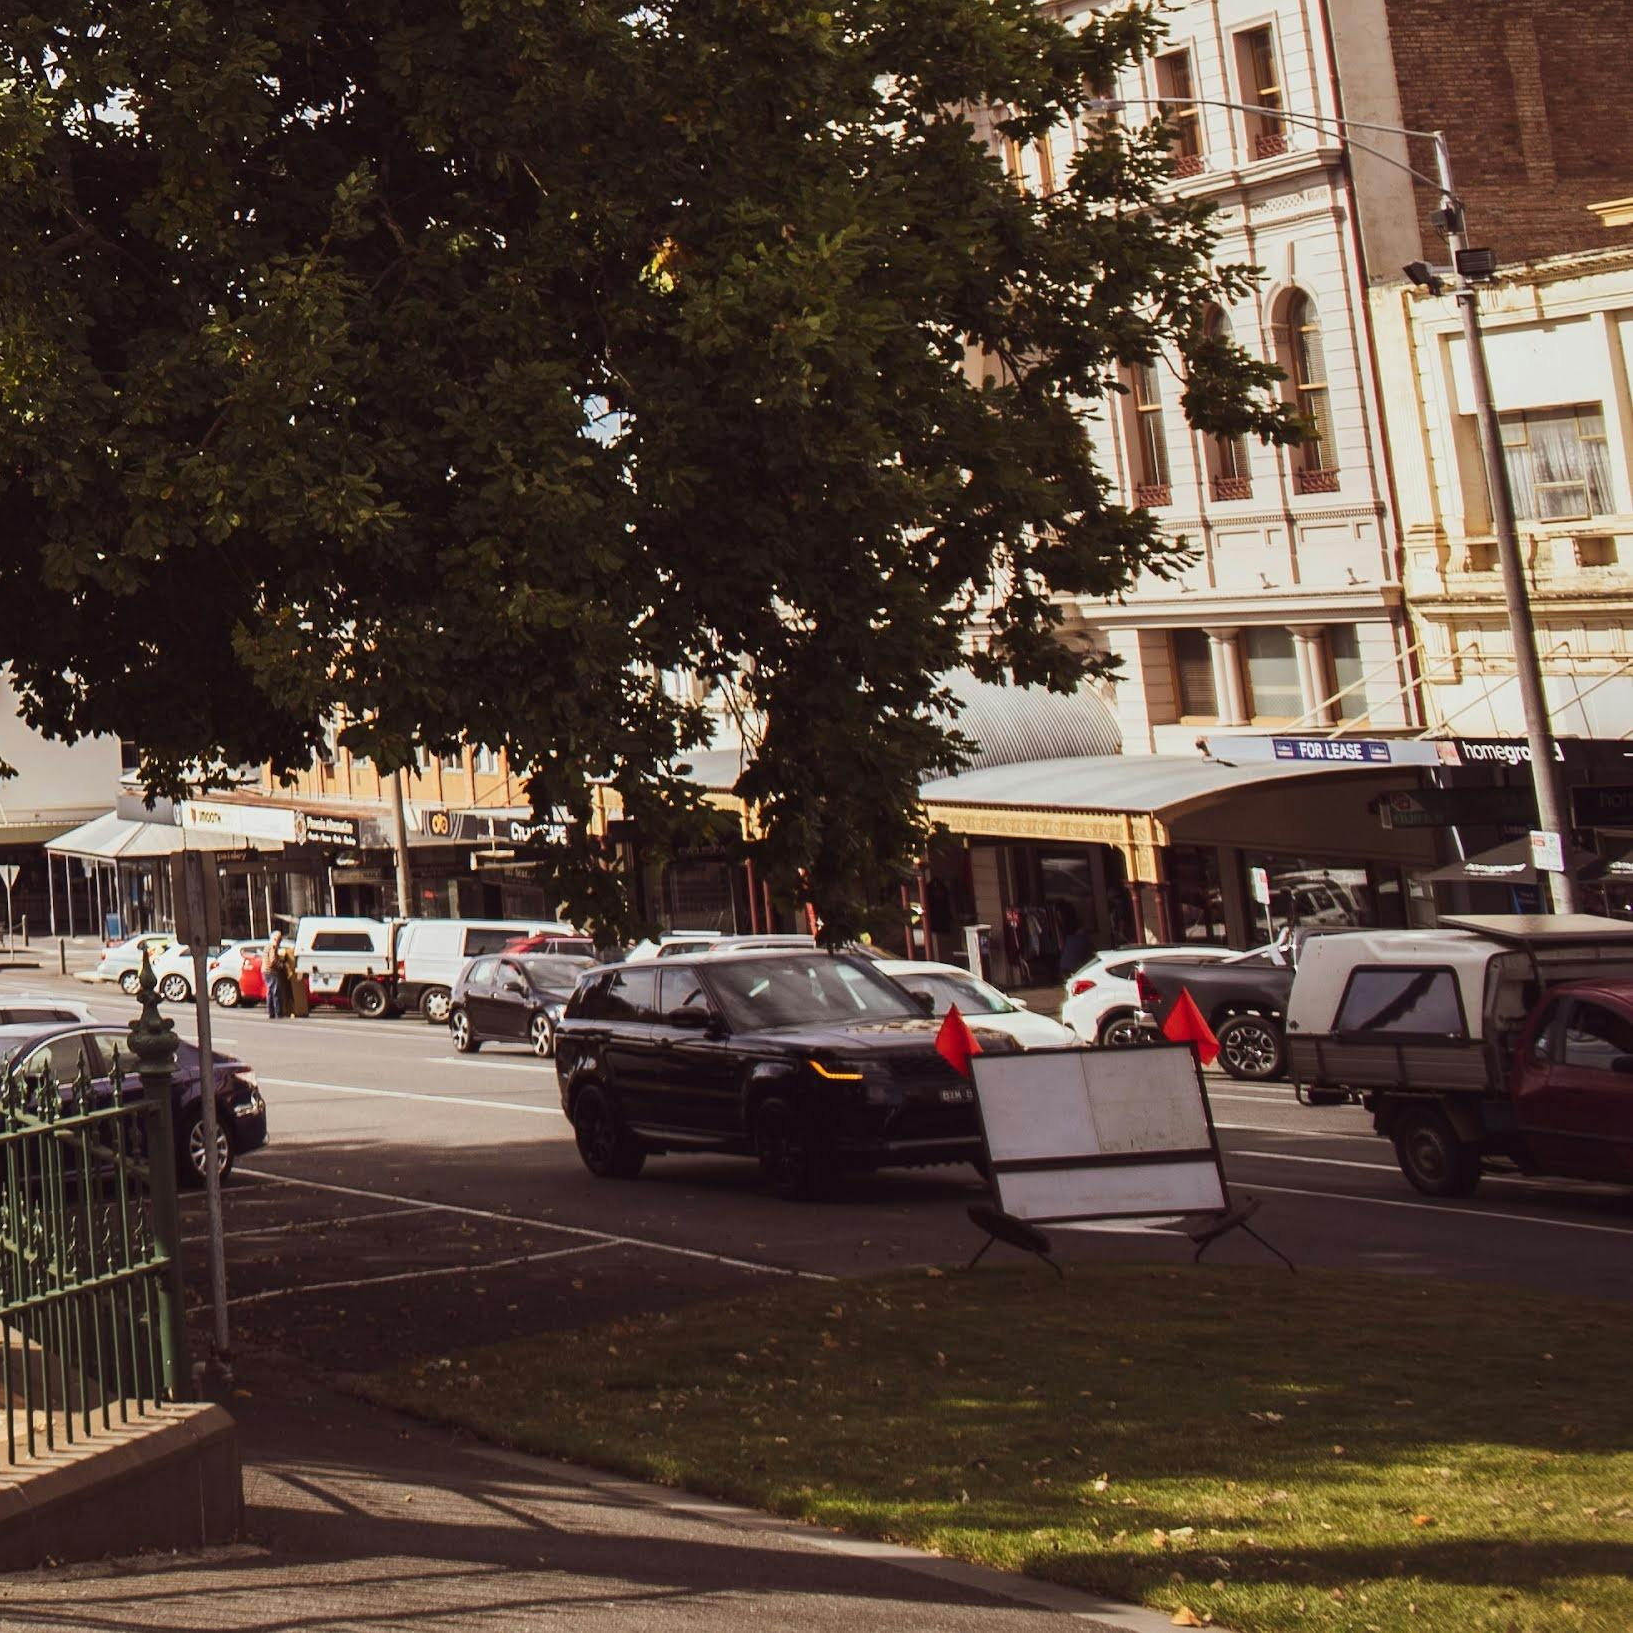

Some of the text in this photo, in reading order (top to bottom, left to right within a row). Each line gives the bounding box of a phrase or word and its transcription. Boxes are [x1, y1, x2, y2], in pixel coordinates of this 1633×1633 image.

[1298, 742, 1324, 759] FOR
[1325, 743, 1365, 761] LEASE
[1462, 740, 1565, 765] homegrod
